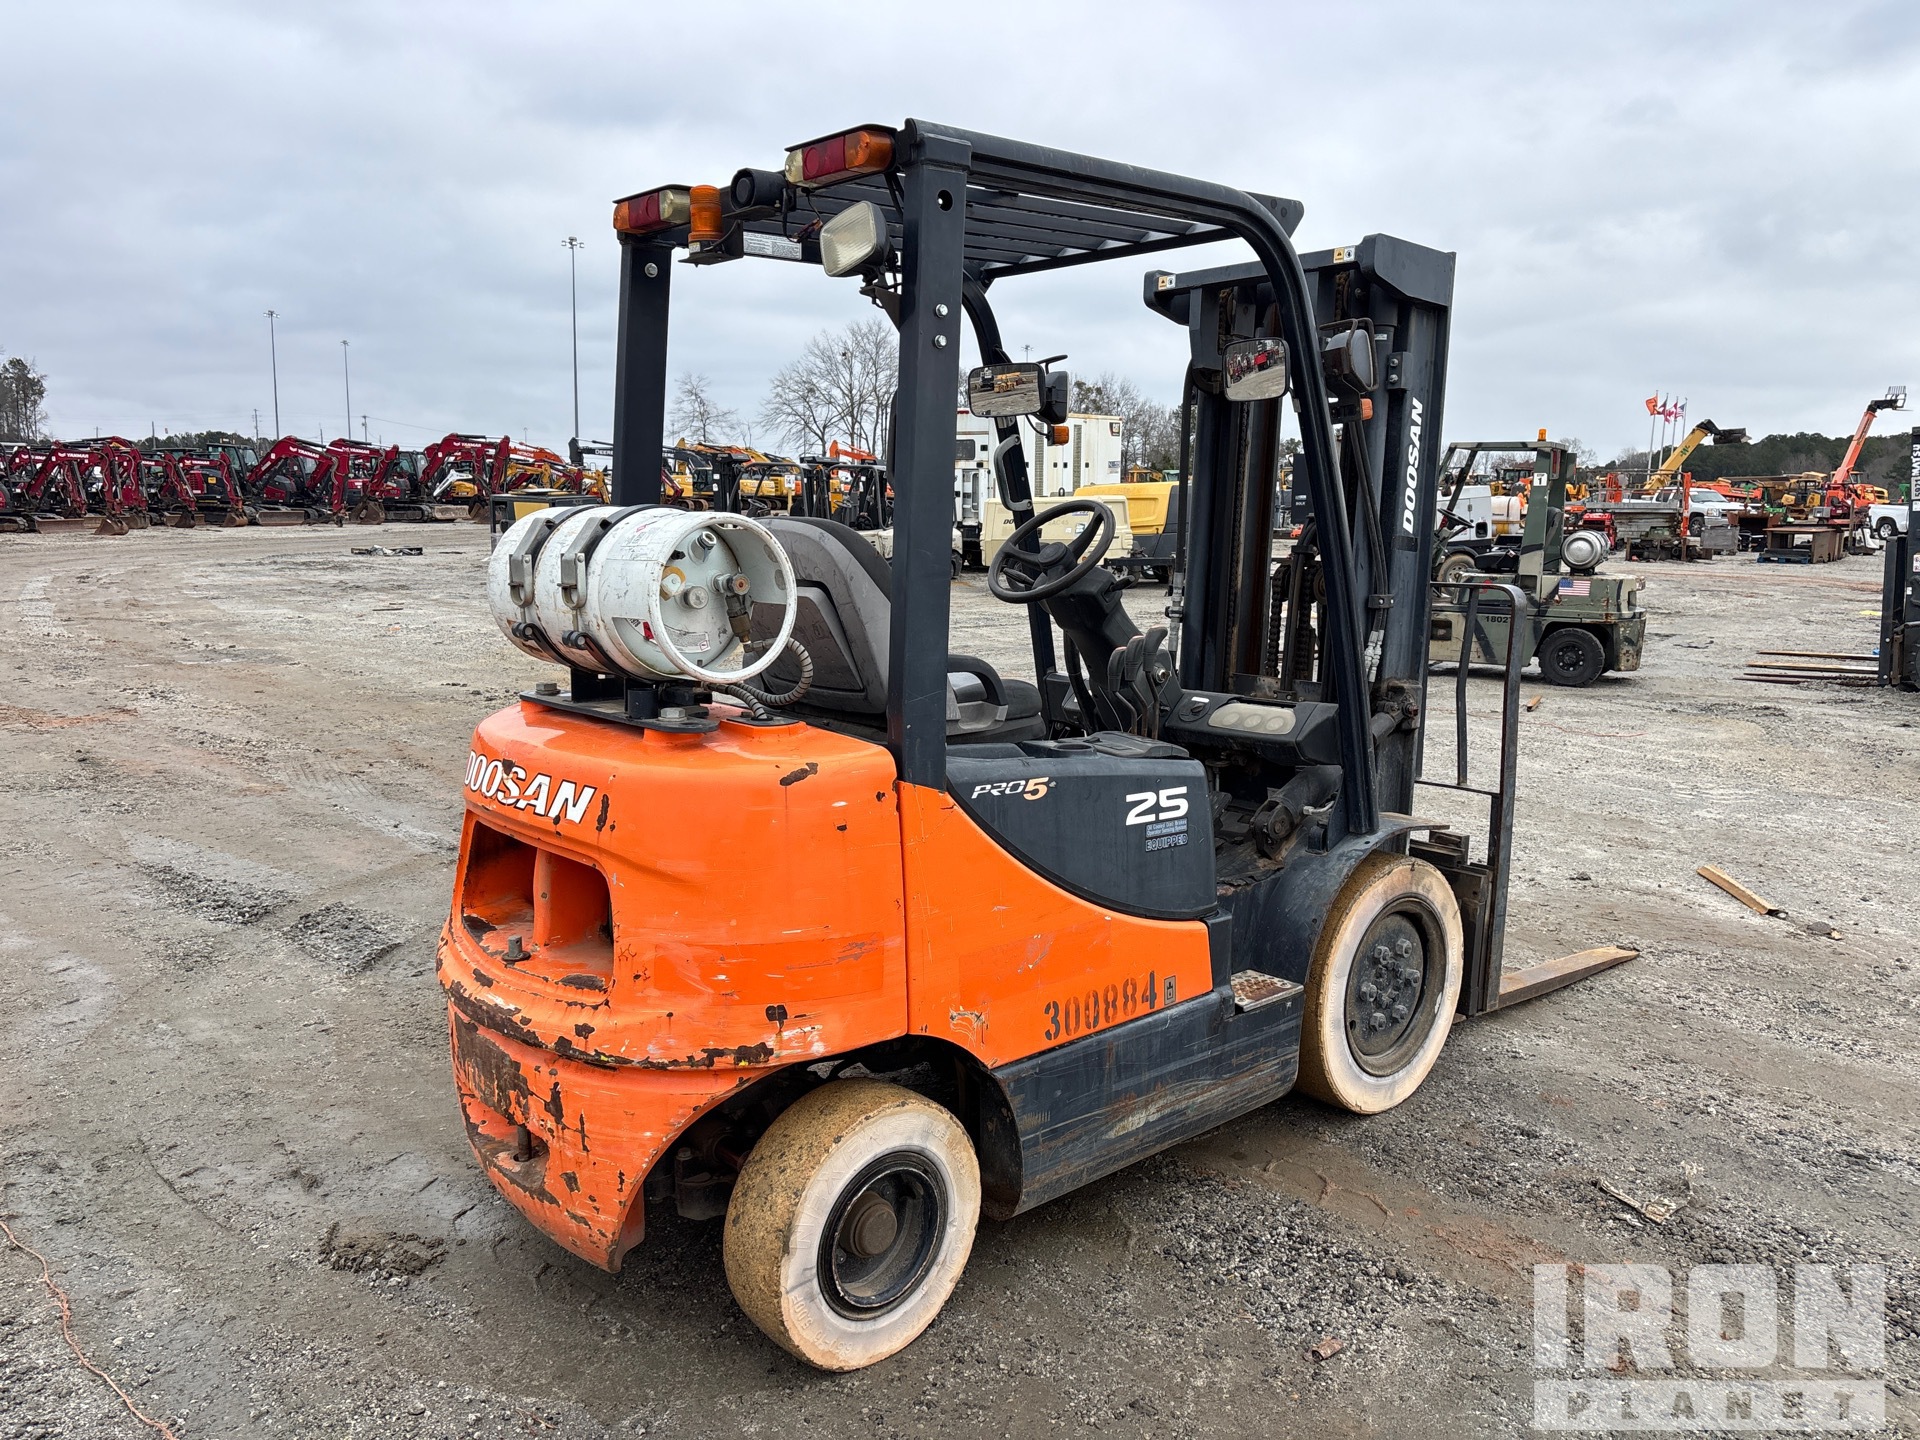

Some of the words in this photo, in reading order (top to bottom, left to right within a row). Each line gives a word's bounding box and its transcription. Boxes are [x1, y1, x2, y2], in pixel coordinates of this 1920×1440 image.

[297, 448, 319, 458] YANMAR
[1402, 396, 1423, 534] DOOSAN
[1911, 444, 1920, 477] MATSU
[1537, 477, 1542, 485] 1
[464, 750, 597, 824] DOOSAN
[971, 776, 1050, 801] PRO5
[1125, 786, 1189, 826] 25
[1145, 833, 1188, 852] EQUIPPED
[1044, 970, 1157, 1041] 300884
